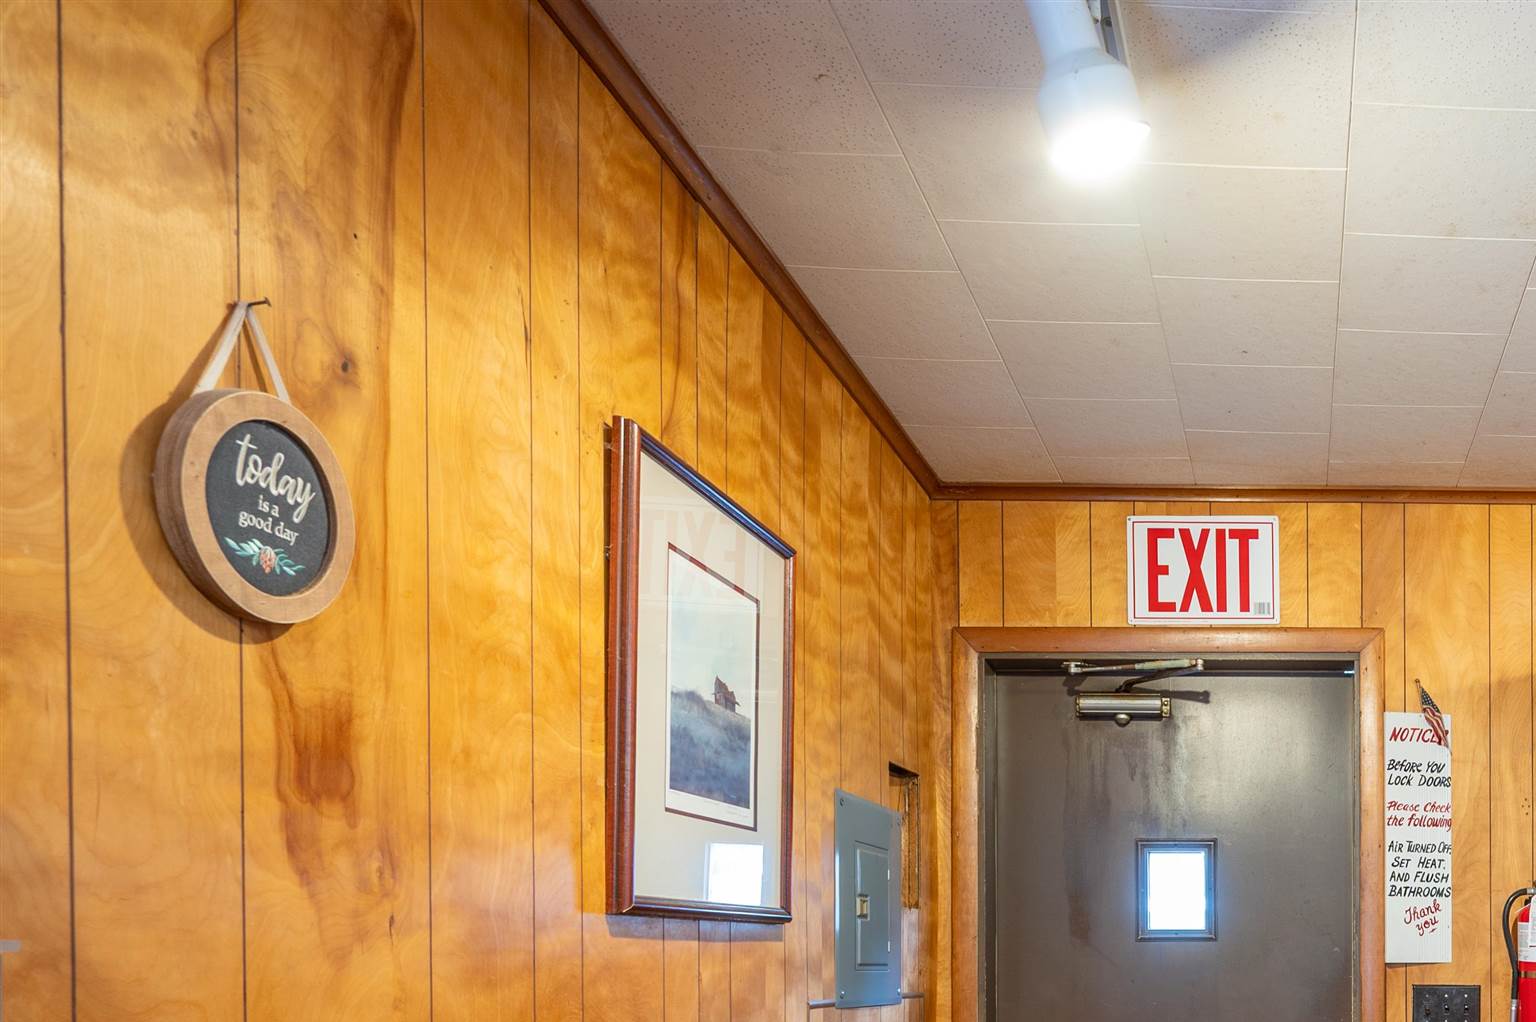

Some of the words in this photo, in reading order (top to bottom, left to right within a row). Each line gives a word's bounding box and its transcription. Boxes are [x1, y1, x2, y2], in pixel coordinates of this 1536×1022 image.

[236, 434, 316, 523] today
[258, 495, 270, 513] is
[271, 504, 280, 517] a
[238, 511, 273, 535] good
[275, 522, 300, 546] day
[1147, 527, 1260, 613] EXIT
[1418, 774, 1452, 788] DOORS
[1387, 801, 1420, 811] Please
[1424, 802, 1451, 813] Check
[1387, 815, 1405, 827] the
[1408, 813, 1452, 832] following
[1406, 840, 1437, 853] TURNED
[1391, 857, 1411, 868] SET
[1389, 871, 1410, 882] AND
[1414, 871, 1449, 883] FLUSH
[1388, 885, 1452, 898] BATHROOMS
[1404, 899, 1442, 925] Thank
[1416, 916, 1439, 936] you
